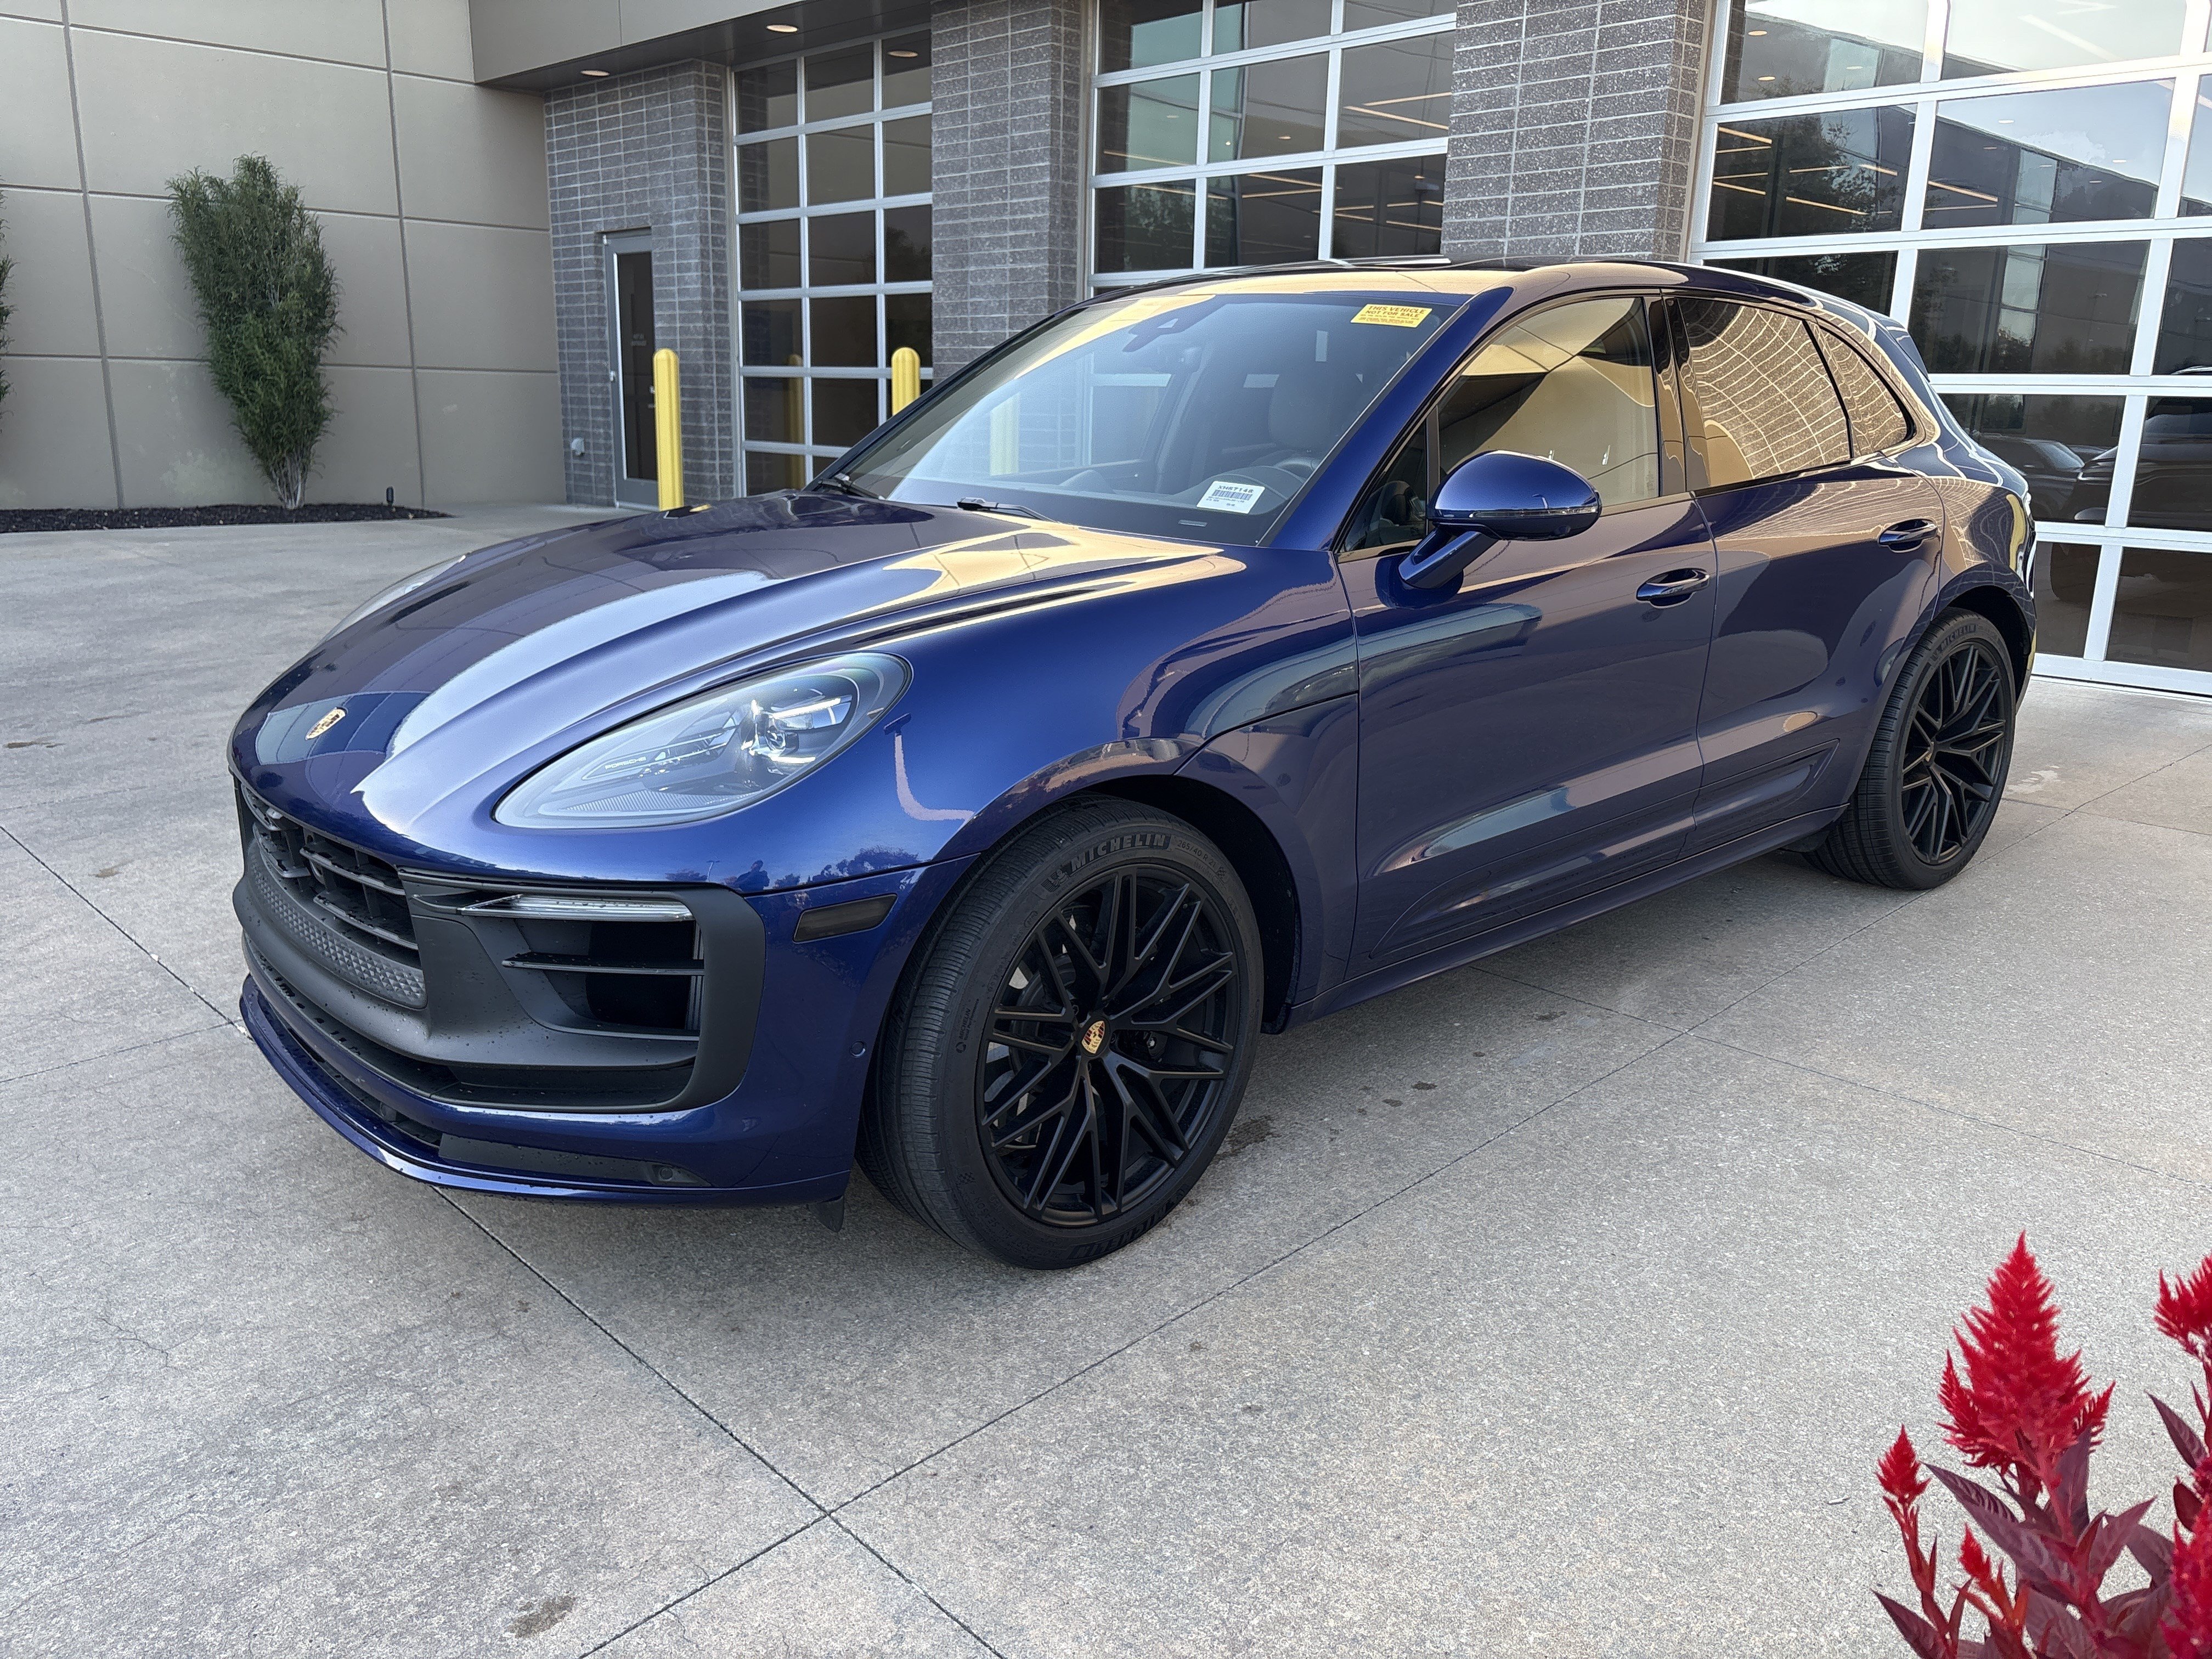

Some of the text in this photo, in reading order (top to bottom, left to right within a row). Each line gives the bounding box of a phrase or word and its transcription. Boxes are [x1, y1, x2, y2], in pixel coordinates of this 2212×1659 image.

[1942, 625, 1975, 650] MICHELIN
[605, 757, 646, 769] PORSCHE
[1071, 833, 1166, 872] MICHELIN
[1177, 840, 1203, 856] 265/40
[1208, 859, 1216, 868] 21
